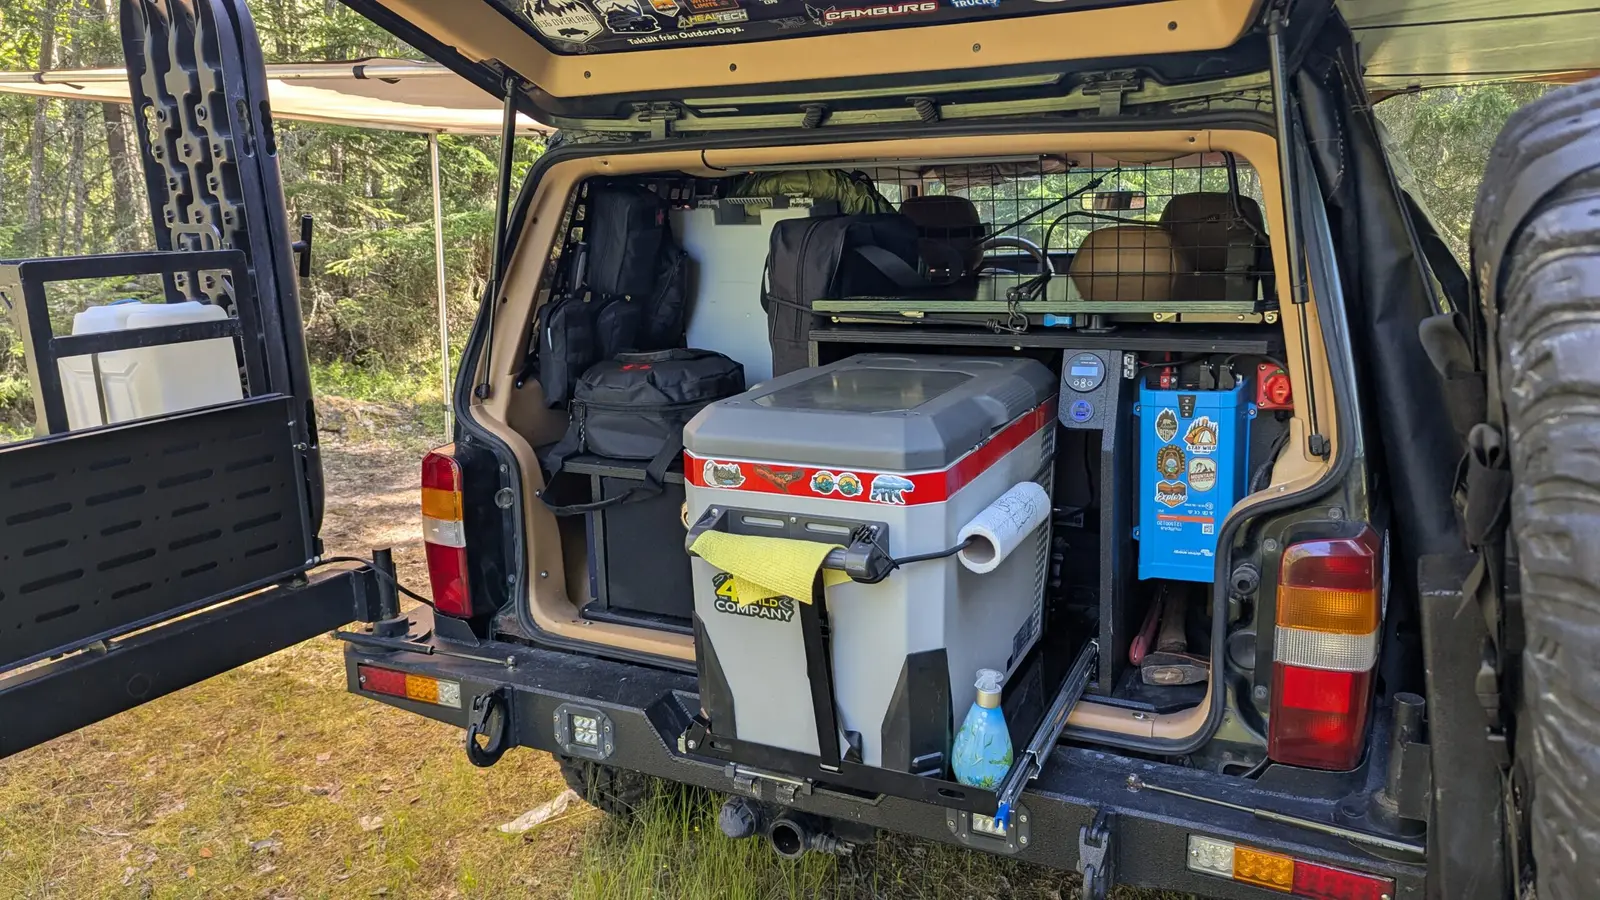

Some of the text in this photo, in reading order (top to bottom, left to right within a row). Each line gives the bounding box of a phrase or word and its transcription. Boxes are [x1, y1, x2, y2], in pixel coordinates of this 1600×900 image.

[552, 14, 595, 27] OVERLAND
[825, 2, 936, 21] CAMBURG
[627, 26, 745, 45] Taktält från OutdoorDays.
[1157, 492, 1187, 501] Explore
[715, 600, 793, 621] COMPANY
